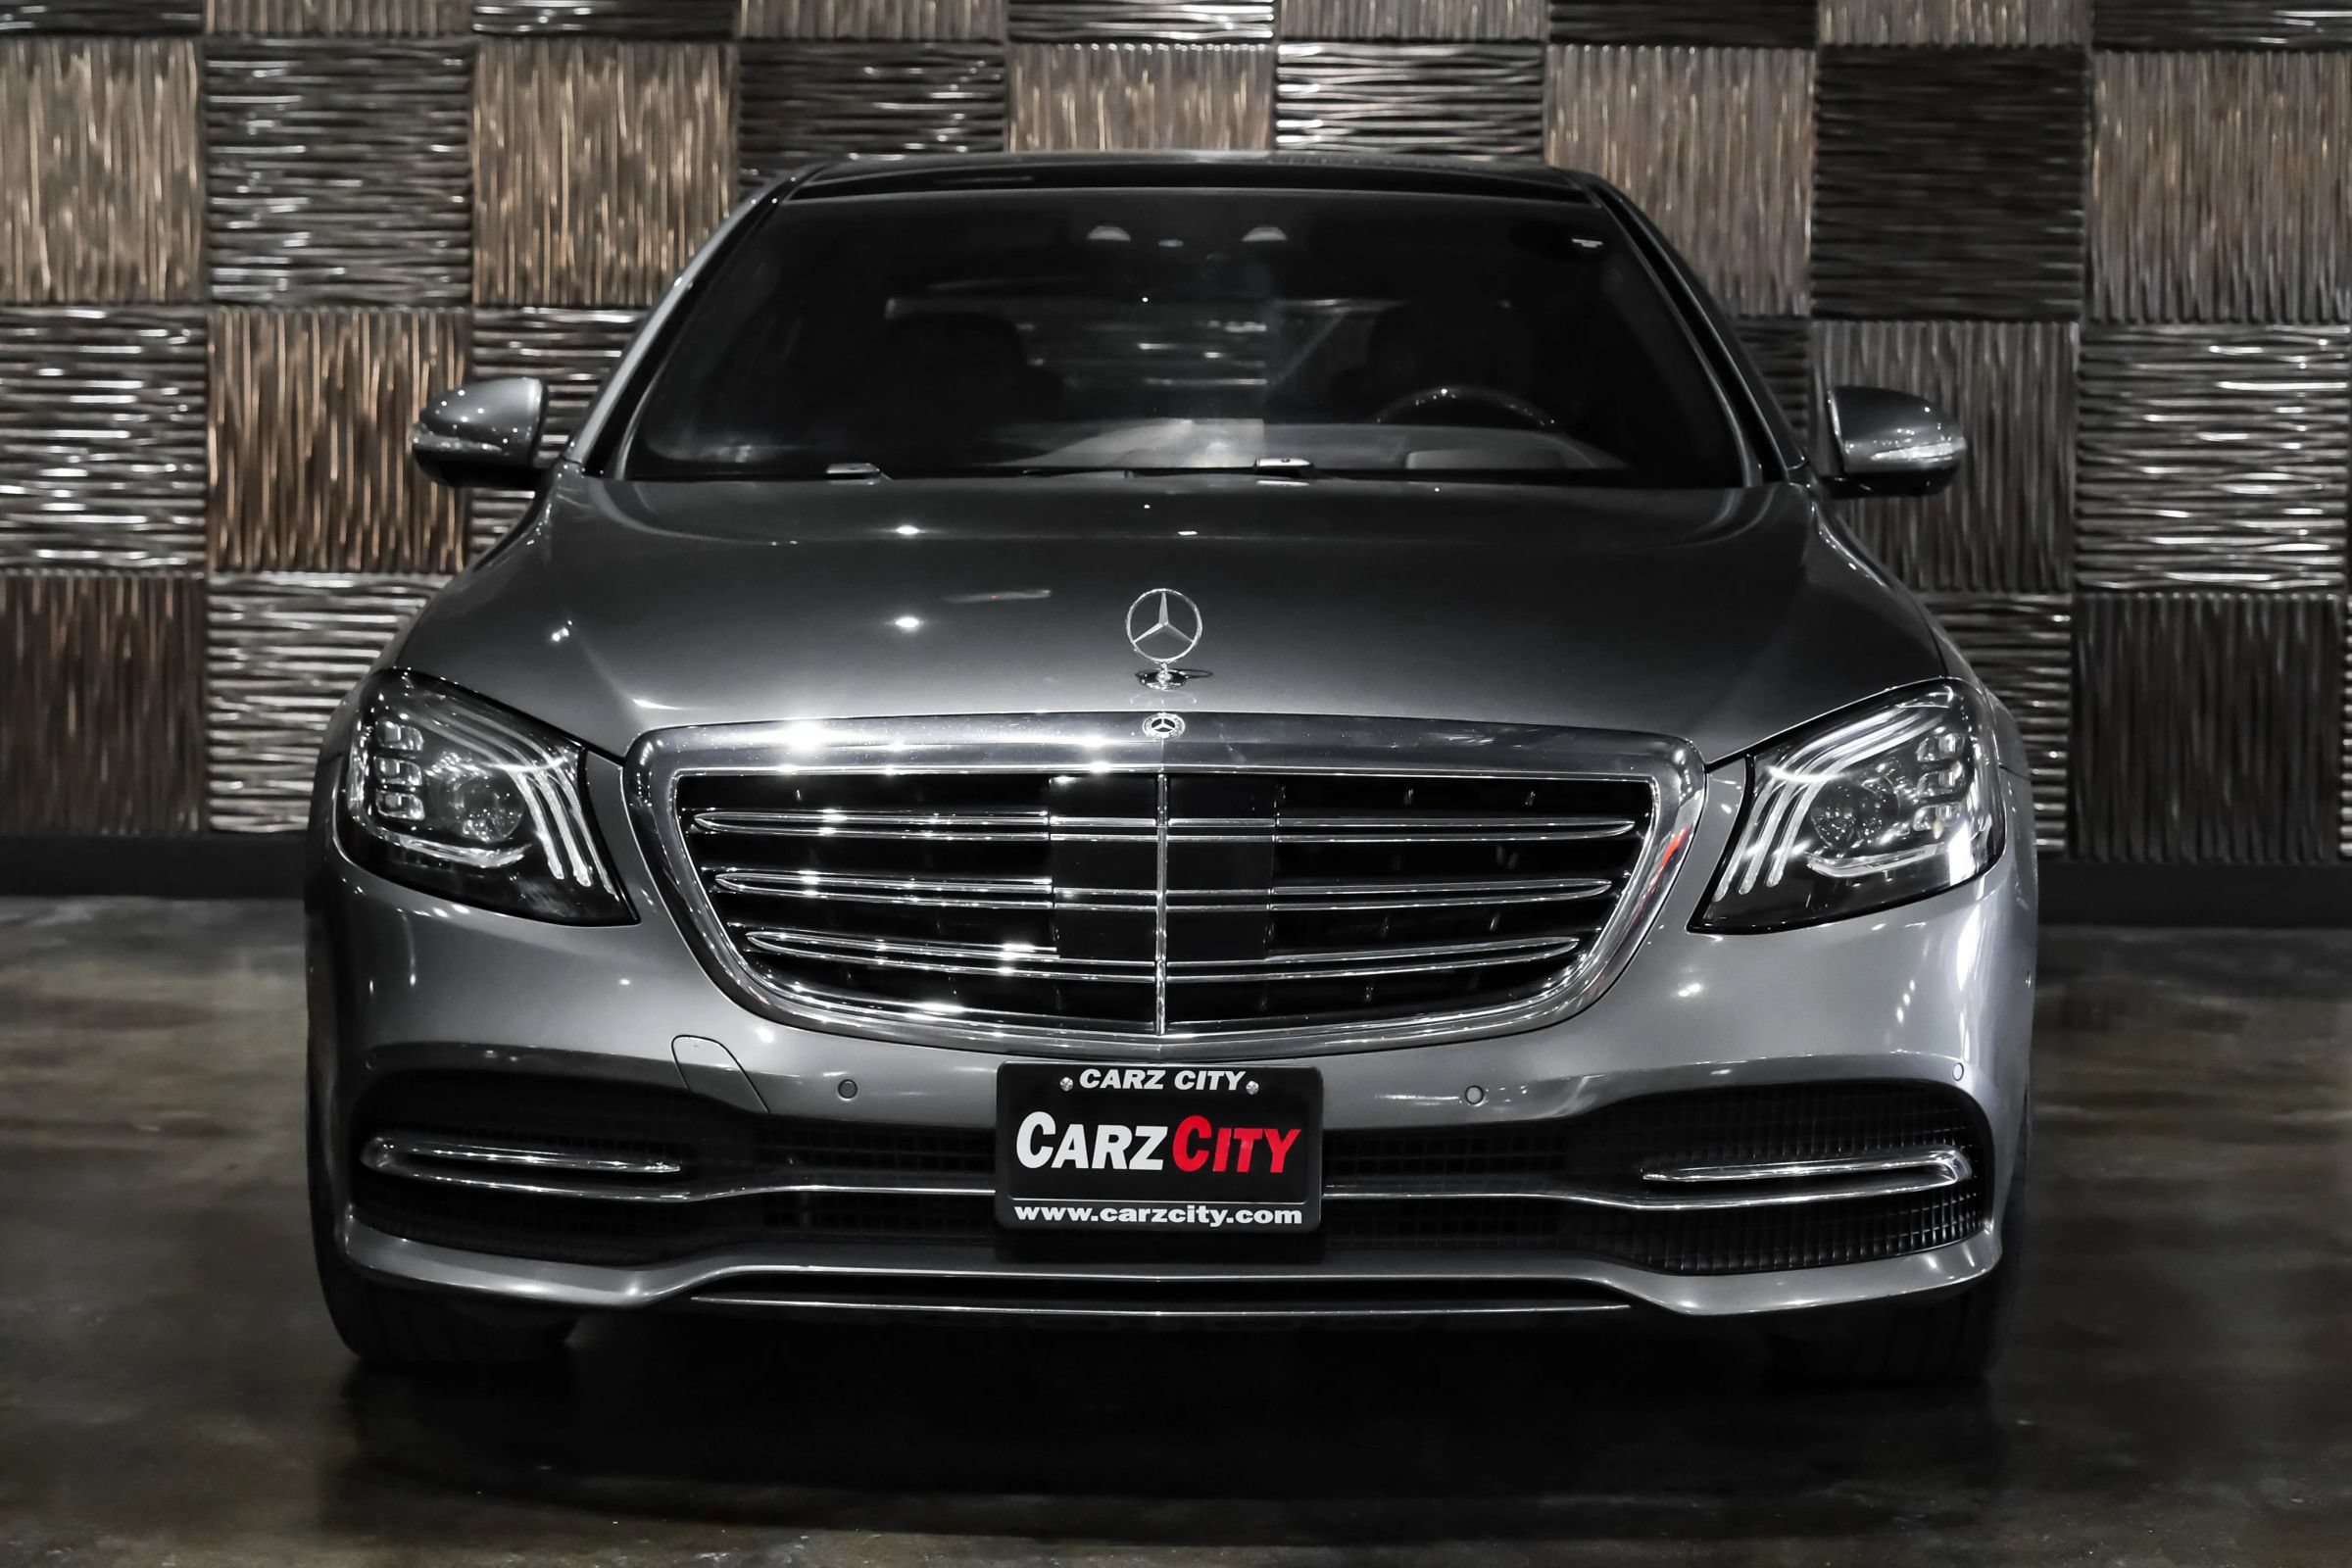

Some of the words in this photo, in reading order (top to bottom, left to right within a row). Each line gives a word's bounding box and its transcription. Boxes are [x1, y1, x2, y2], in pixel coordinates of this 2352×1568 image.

[1079, 1068, 1166, 1090] CARZ
[1174, 1069, 1246, 1091] CITY
[1014, 1204, 1302, 1227] www.carzcity.com
